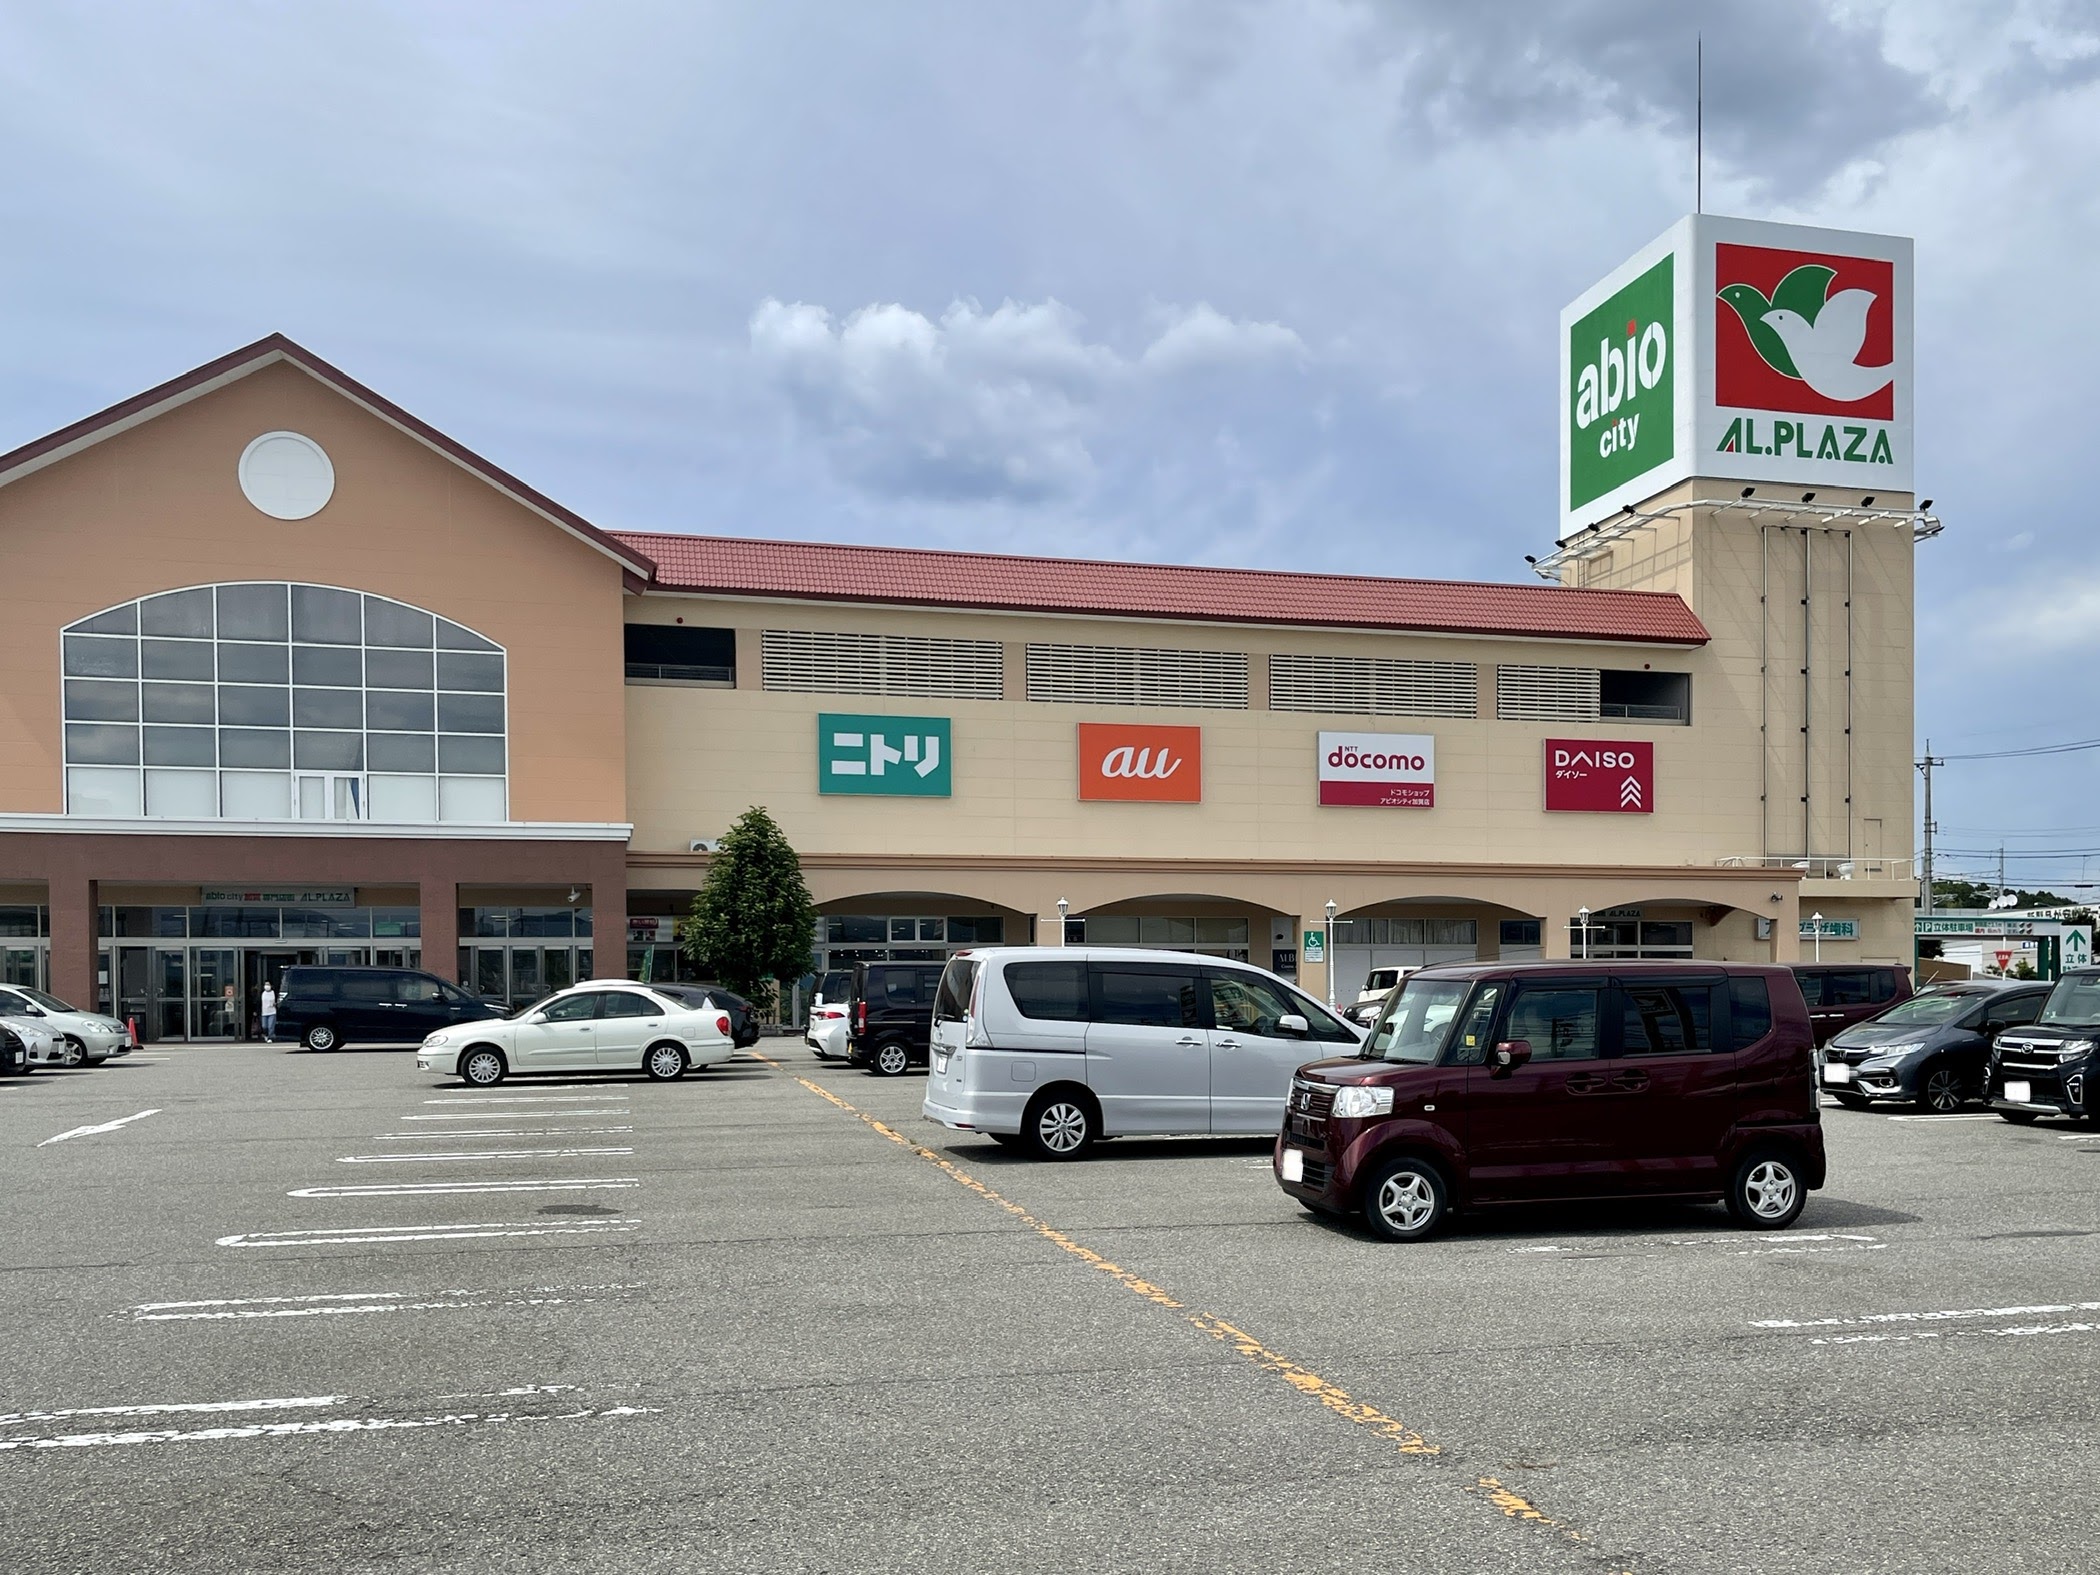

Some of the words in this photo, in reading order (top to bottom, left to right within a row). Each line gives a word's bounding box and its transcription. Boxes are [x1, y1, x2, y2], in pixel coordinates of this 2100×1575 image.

[1576, 319, 1667, 430] abio
[1600, 413, 1640, 458] city
[1716, 417, 1894, 465] AL.PLAZA
[831, 732, 940, 779] ニトリ
[1101, 746, 1183, 779] au
[1328, 746, 1425, 771] docomo
[1555, 749, 1635, 769] DAISO
[1555, 769, 1588, 779] ダイソー
[1390, 789, 1430, 797] ドコモショップ
[1933, 922, 1974, 933] 立体駐車場
[2065, 953, 2087, 964] 立体
